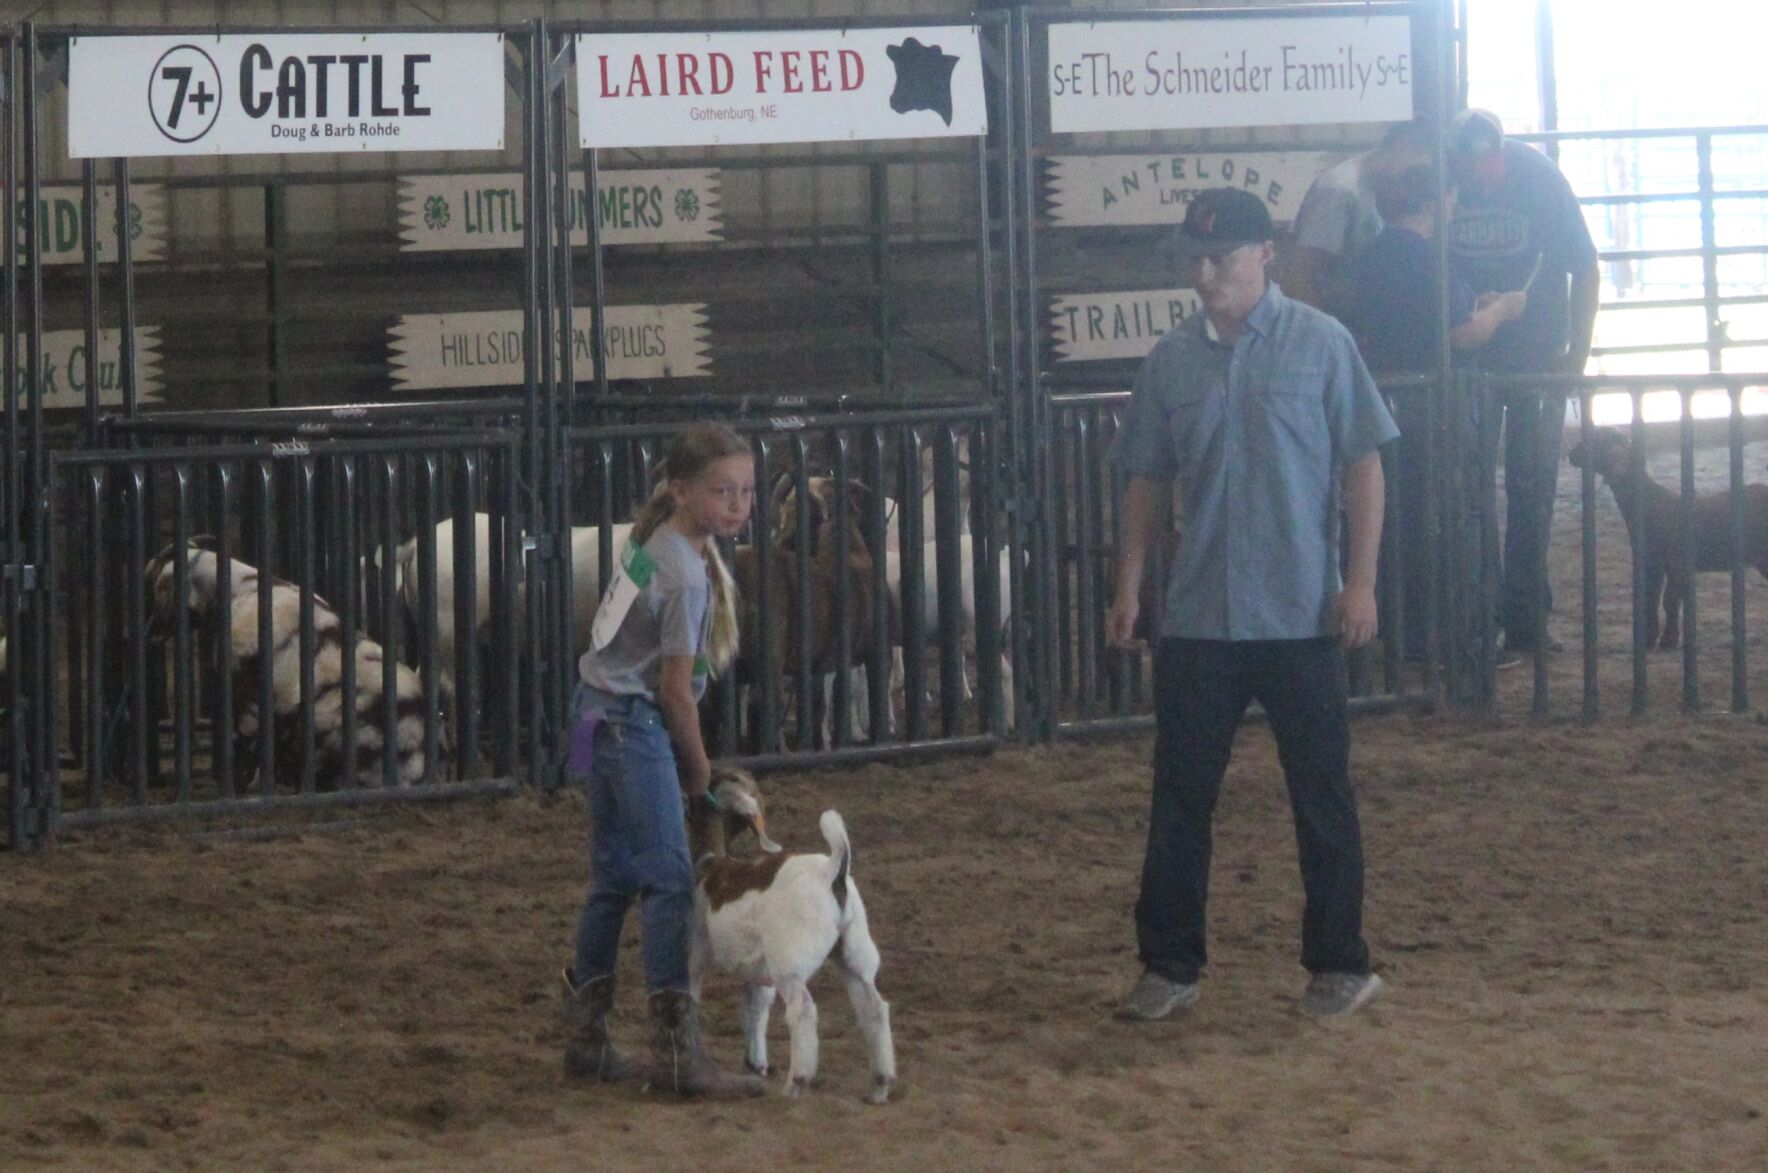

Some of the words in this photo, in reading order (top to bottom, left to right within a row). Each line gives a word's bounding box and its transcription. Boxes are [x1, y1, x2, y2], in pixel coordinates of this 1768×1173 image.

[598, 53, 734, 98] LAIRD
[753, 49, 865, 94] FEED
[1082, 53, 1136, 97] The
[1143, 50, 1273, 96] Schneider
[1281, 45, 1372, 100] Family
[271, 124, 307, 141] Doug
[310, 124, 320, 137] &
[324, 122, 356, 137] Barb
[359, 122, 400, 137] Rohde
[690, 106, 758, 121] Gothenburg,
[761, 105, 778, 118] NE
[1102, 157, 1283, 210] ANTELOPE
[464, 189, 527, 233] LITTL
[441, 331, 526, 367] HILLSID
